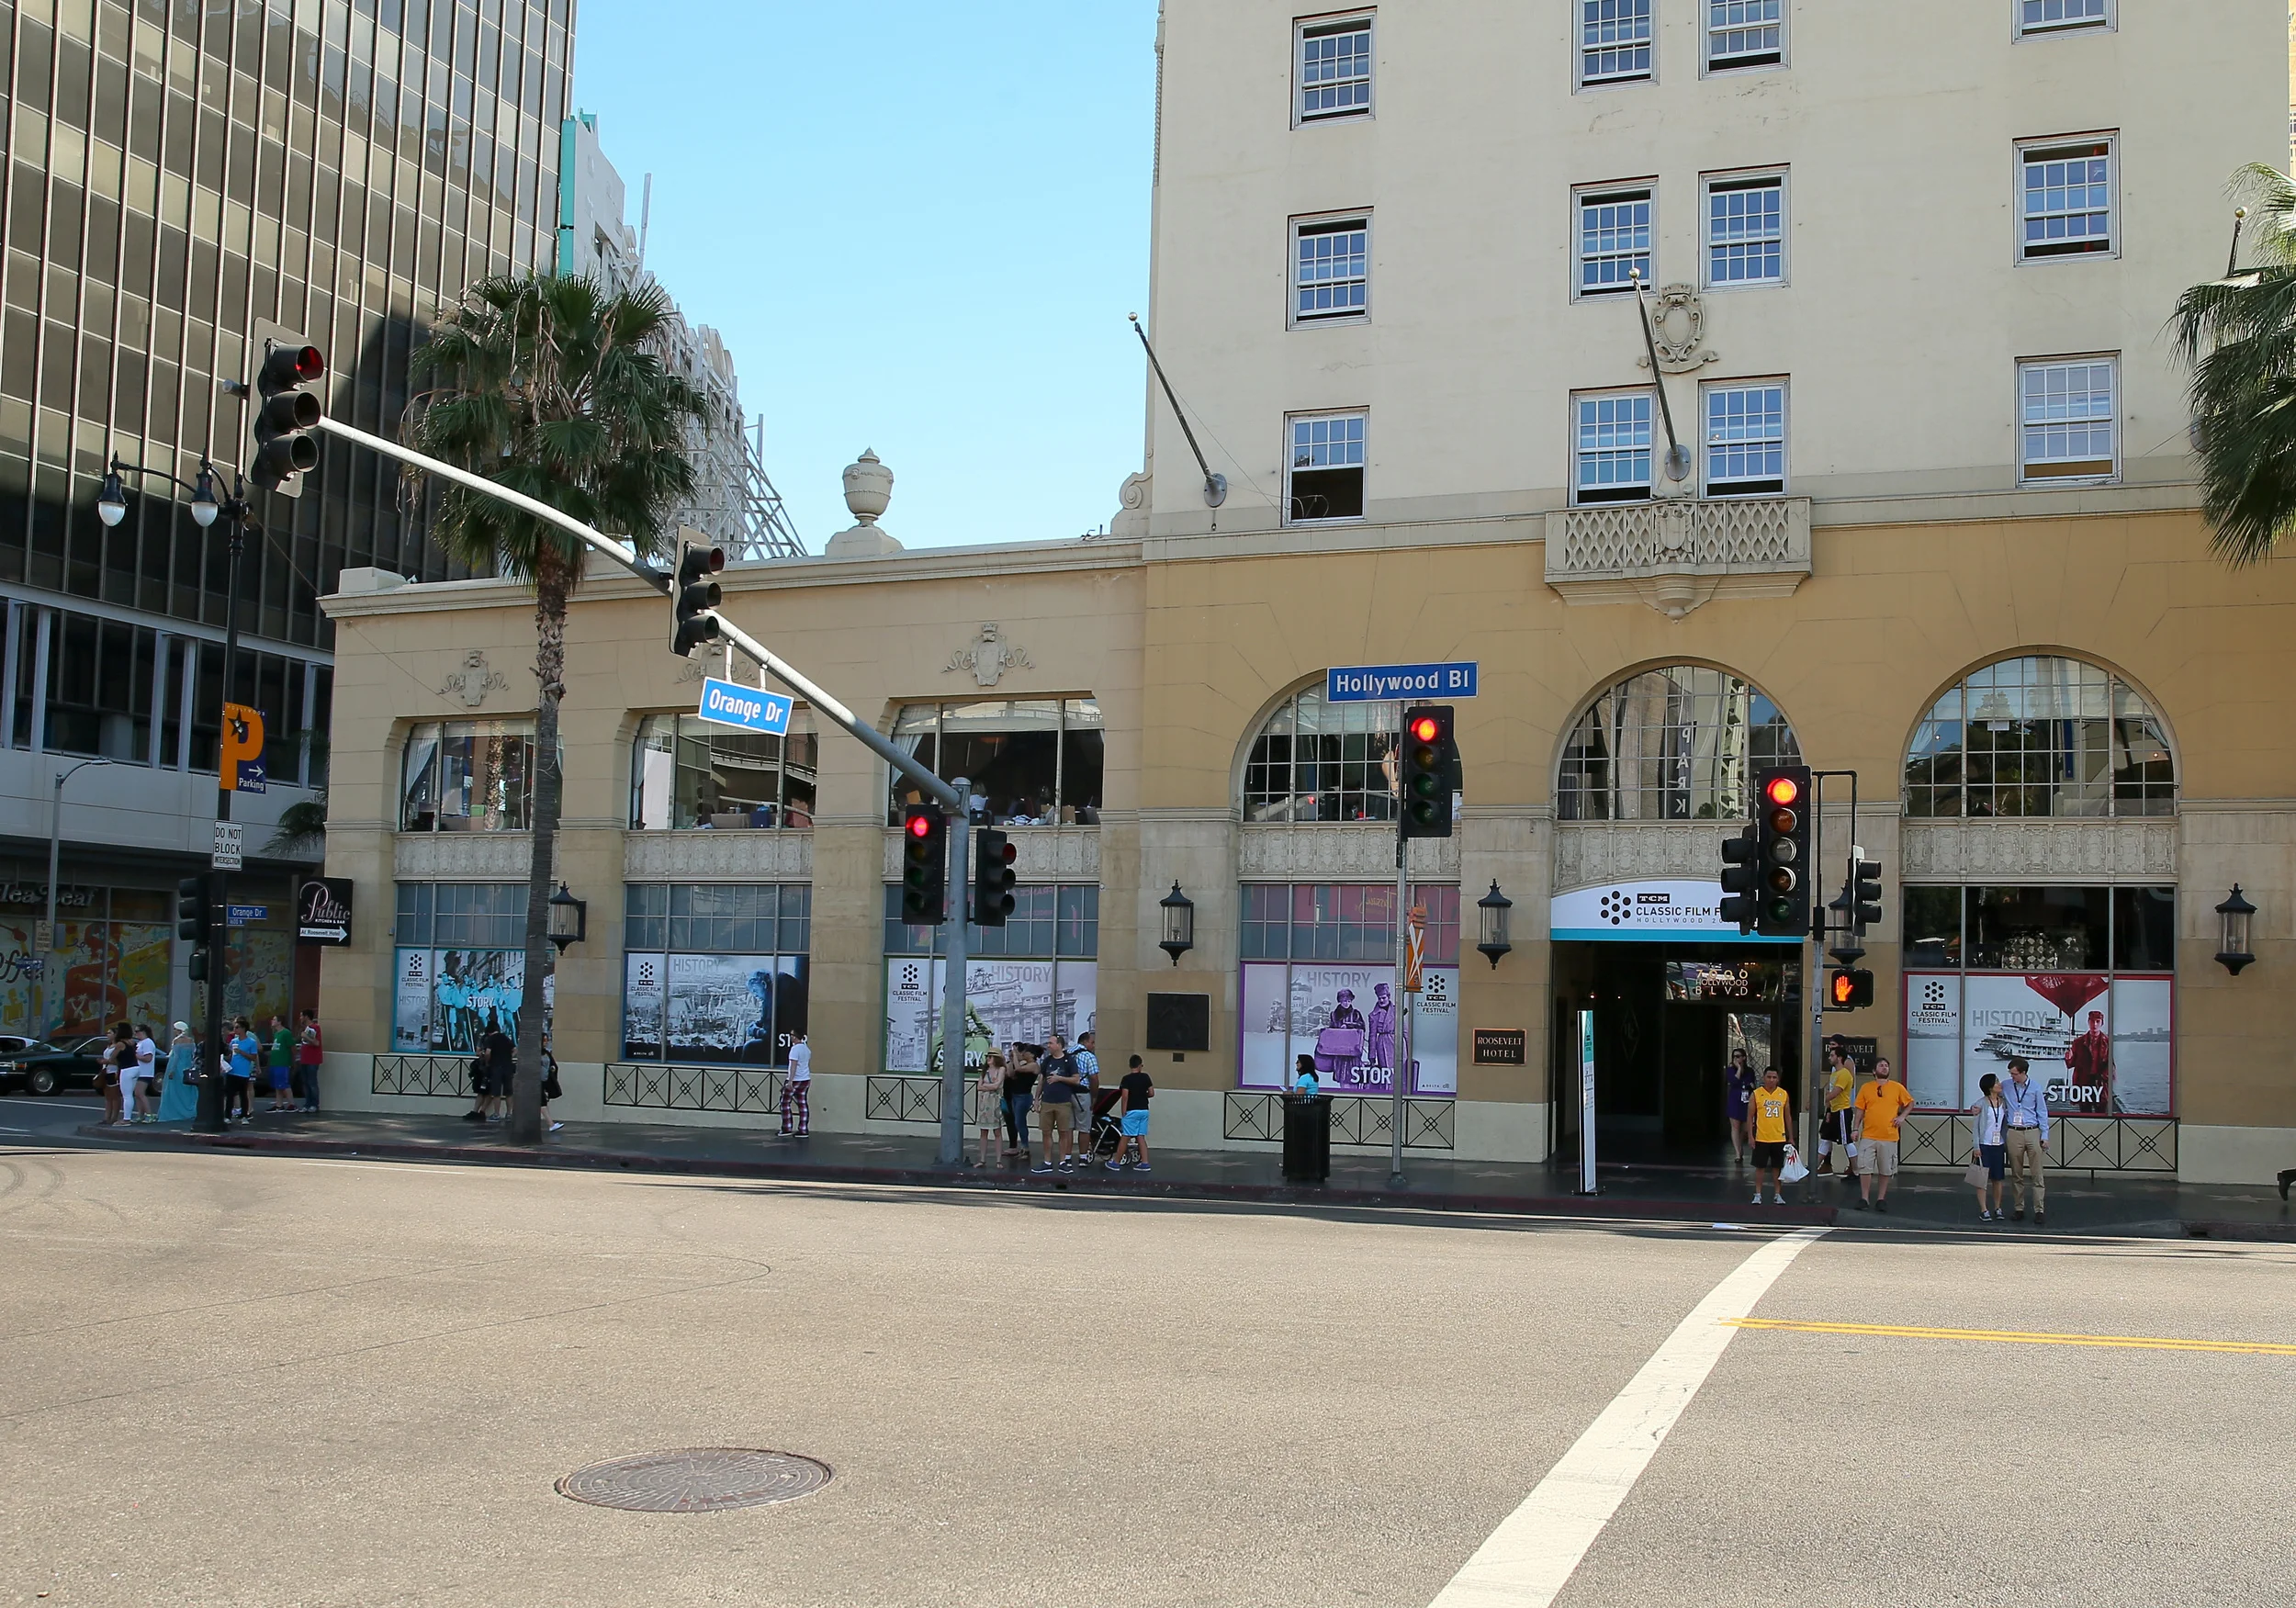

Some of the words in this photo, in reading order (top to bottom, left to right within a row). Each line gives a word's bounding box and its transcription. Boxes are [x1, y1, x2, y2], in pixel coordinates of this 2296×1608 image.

[1336, 670, 1439, 696] Hollywood
[1448, 669, 1469, 688] Bl
[708, 688, 761, 724] Orange
[764, 701, 784, 724] Dr
[239, 777, 264, 792] Parking
[215, 826, 226, 838] DO
[228, 828, 242, 840] NOT
[214, 842, 241, 855] BLOCK
[214, 856, 241, 866] INTERSECTION
[299, 881, 351, 924] Public
[232, 907, 254, 918] Orange
[254, 908, 263, 916] Dr
[1636, 906, 1683, 916] CLASSIC
[1684, 907, 1711, 916] FILM
[673, 958, 721, 973] HISTORY
[991, 965, 1052, 983] HISTORY
[1307, 971, 1372, 988] HISTORY
[1695, 969, 1749, 980] 7000
[1695, 985, 1749, 995] BLVD
[399, 995, 430, 1006] HISTORY
[467, 995, 495, 1008] STORY
[1972, 1009, 2047, 1027] HISTORY
[1478, 1037, 1523, 1045] ROOSEVELT
[937, 1050, 983, 1067] SRY
[1483, 1049, 1516, 1058] HOTEL
[1350, 1065, 1395, 1085] STOR
[2047, 1084, 2104, 1102] STORY
[1765, 1107, 1779, 1118] 24
